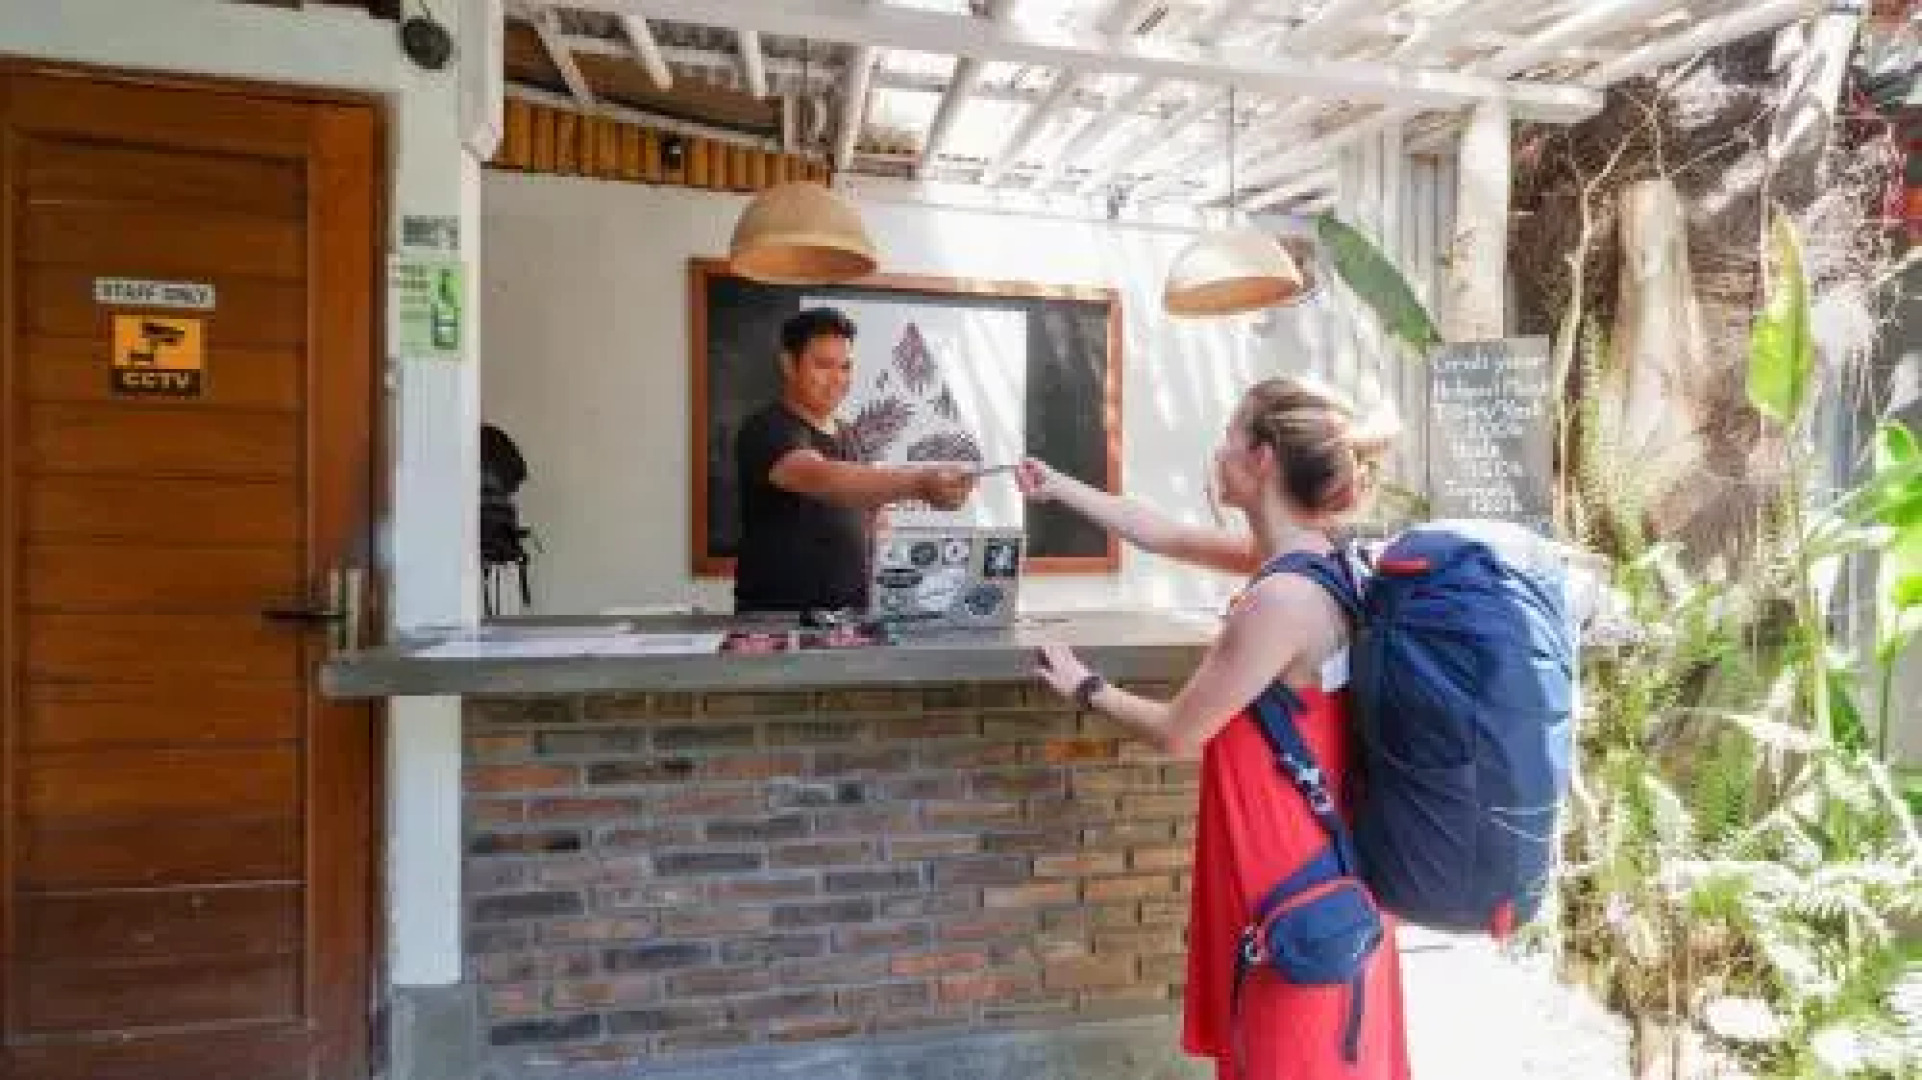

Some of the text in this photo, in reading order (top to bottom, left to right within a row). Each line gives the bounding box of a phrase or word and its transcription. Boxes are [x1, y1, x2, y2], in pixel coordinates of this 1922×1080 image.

[101, 282, 209, 306] STAFF ONLY
[121, 371, 191, 390] CCTV
